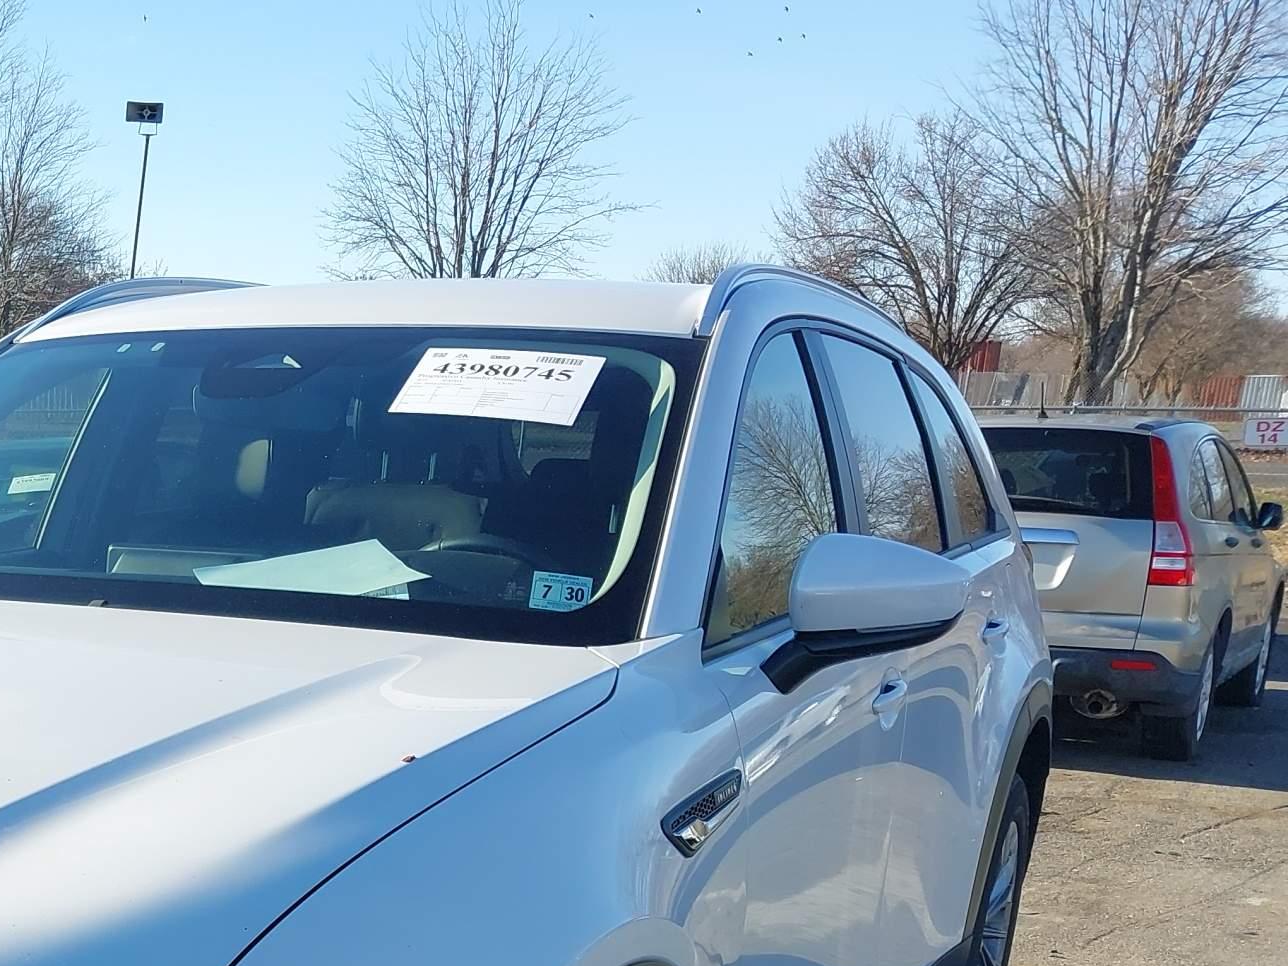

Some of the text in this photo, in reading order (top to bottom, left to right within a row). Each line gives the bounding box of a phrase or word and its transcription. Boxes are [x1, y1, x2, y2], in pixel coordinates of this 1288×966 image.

[433, 362, 576, 382] 43980745
[1256, 421, 1285, 433] DZ
[1259, 433, 1278, 444] 14
[542, 584, 585, 603] 7 30
